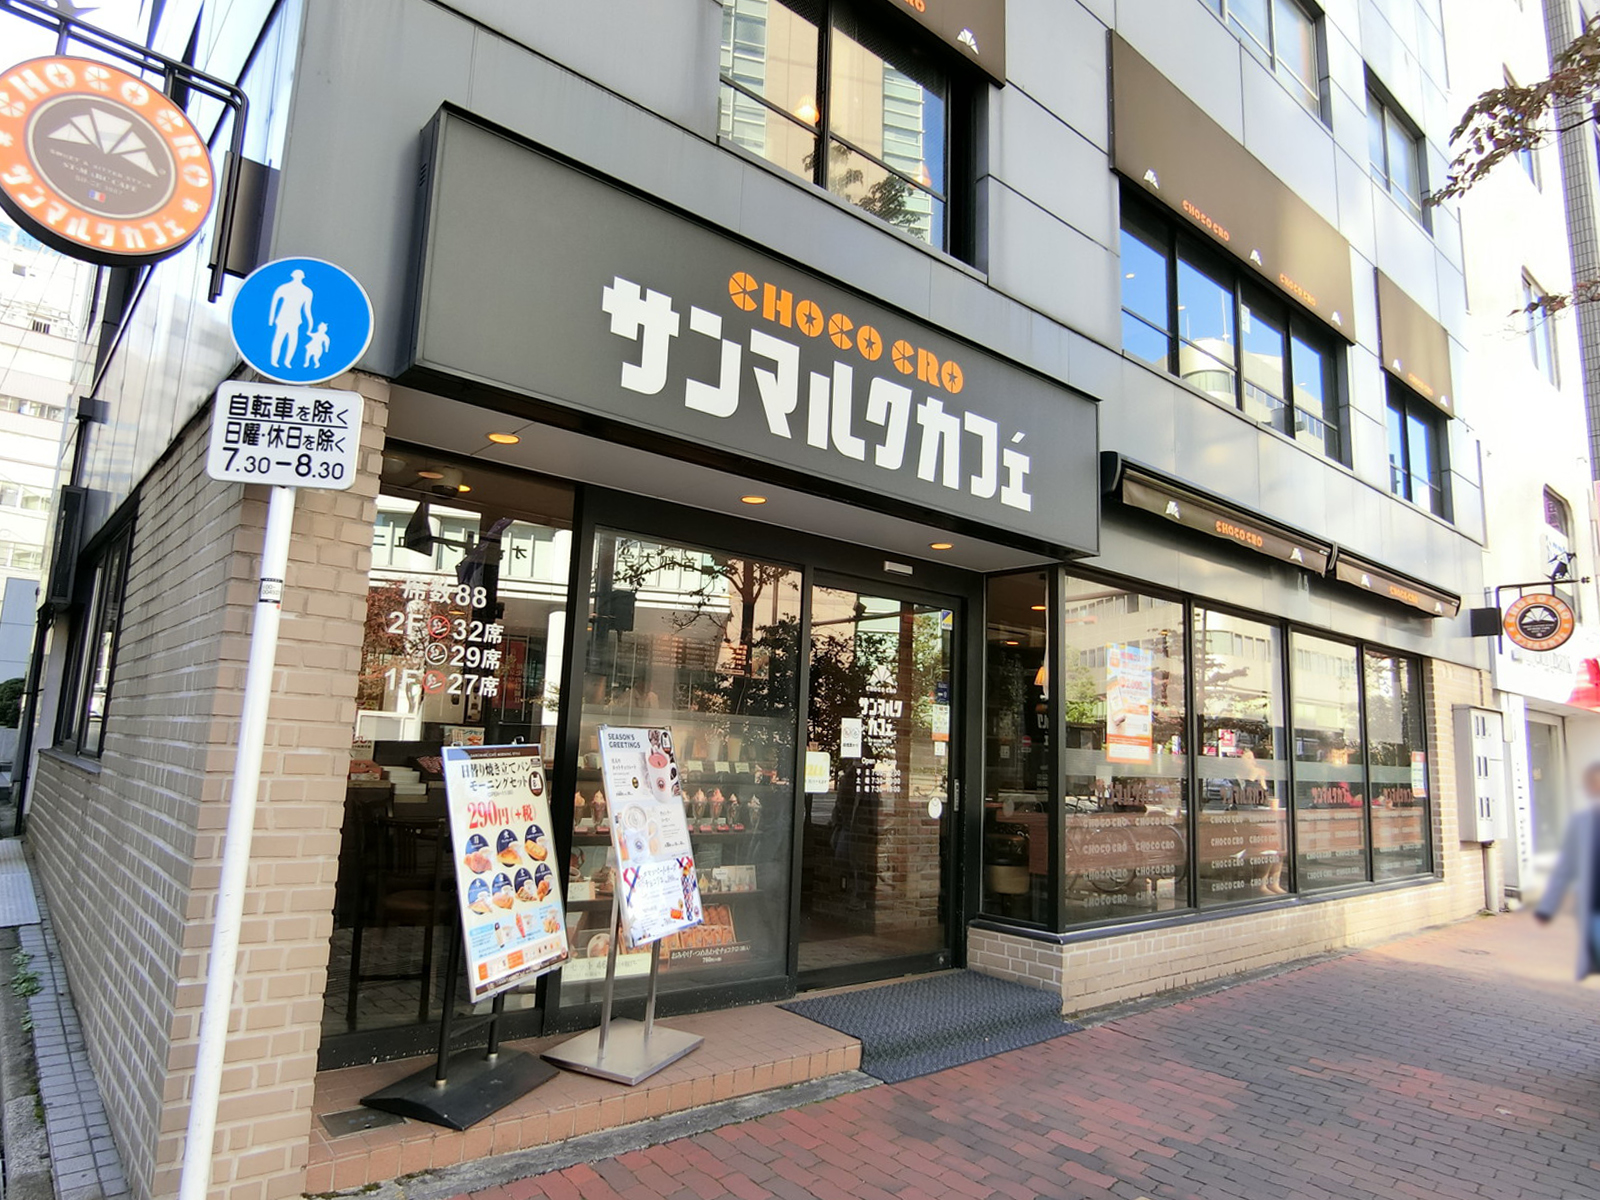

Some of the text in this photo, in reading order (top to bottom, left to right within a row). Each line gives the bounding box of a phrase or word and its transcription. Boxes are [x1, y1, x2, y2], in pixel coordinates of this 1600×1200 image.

[0, 63, 209, 188] CHOCO CRO
[1182, 199, 1230, 242] CHOCO CRO
[729, 271, 963, 394] CHOCO CRO
[602, 275, 1032, 512] サンマルクカフェ
[228, 393, 349, 425] 自転車を除く
[1215, 520, 1263, 547] CHOCO CRO
[388, 611, 504, 644] 2F 32席
[450, 645, 502, 670] 29席
[385, 667, 419, 691] 1F
[447, 673, 500, 698] 27席
[859, 697, 903, 717] サンマルク
[470, 775, 528, 791] モーニングセット
[1083, 843, 1127, 855] CHOCO CRO
[1135, 840, 1175, 851] CHOCO CRO
[1211, 836, 1244, 847] CHOCO CRO
[1136, 864, 1175, 876] CHOCO CRO
[1211, 859, 1232, 869] CHOCO
[1212, 880, 1245, 892] CHOCO CRO
[1112, 894, 1127, 904] CRO
